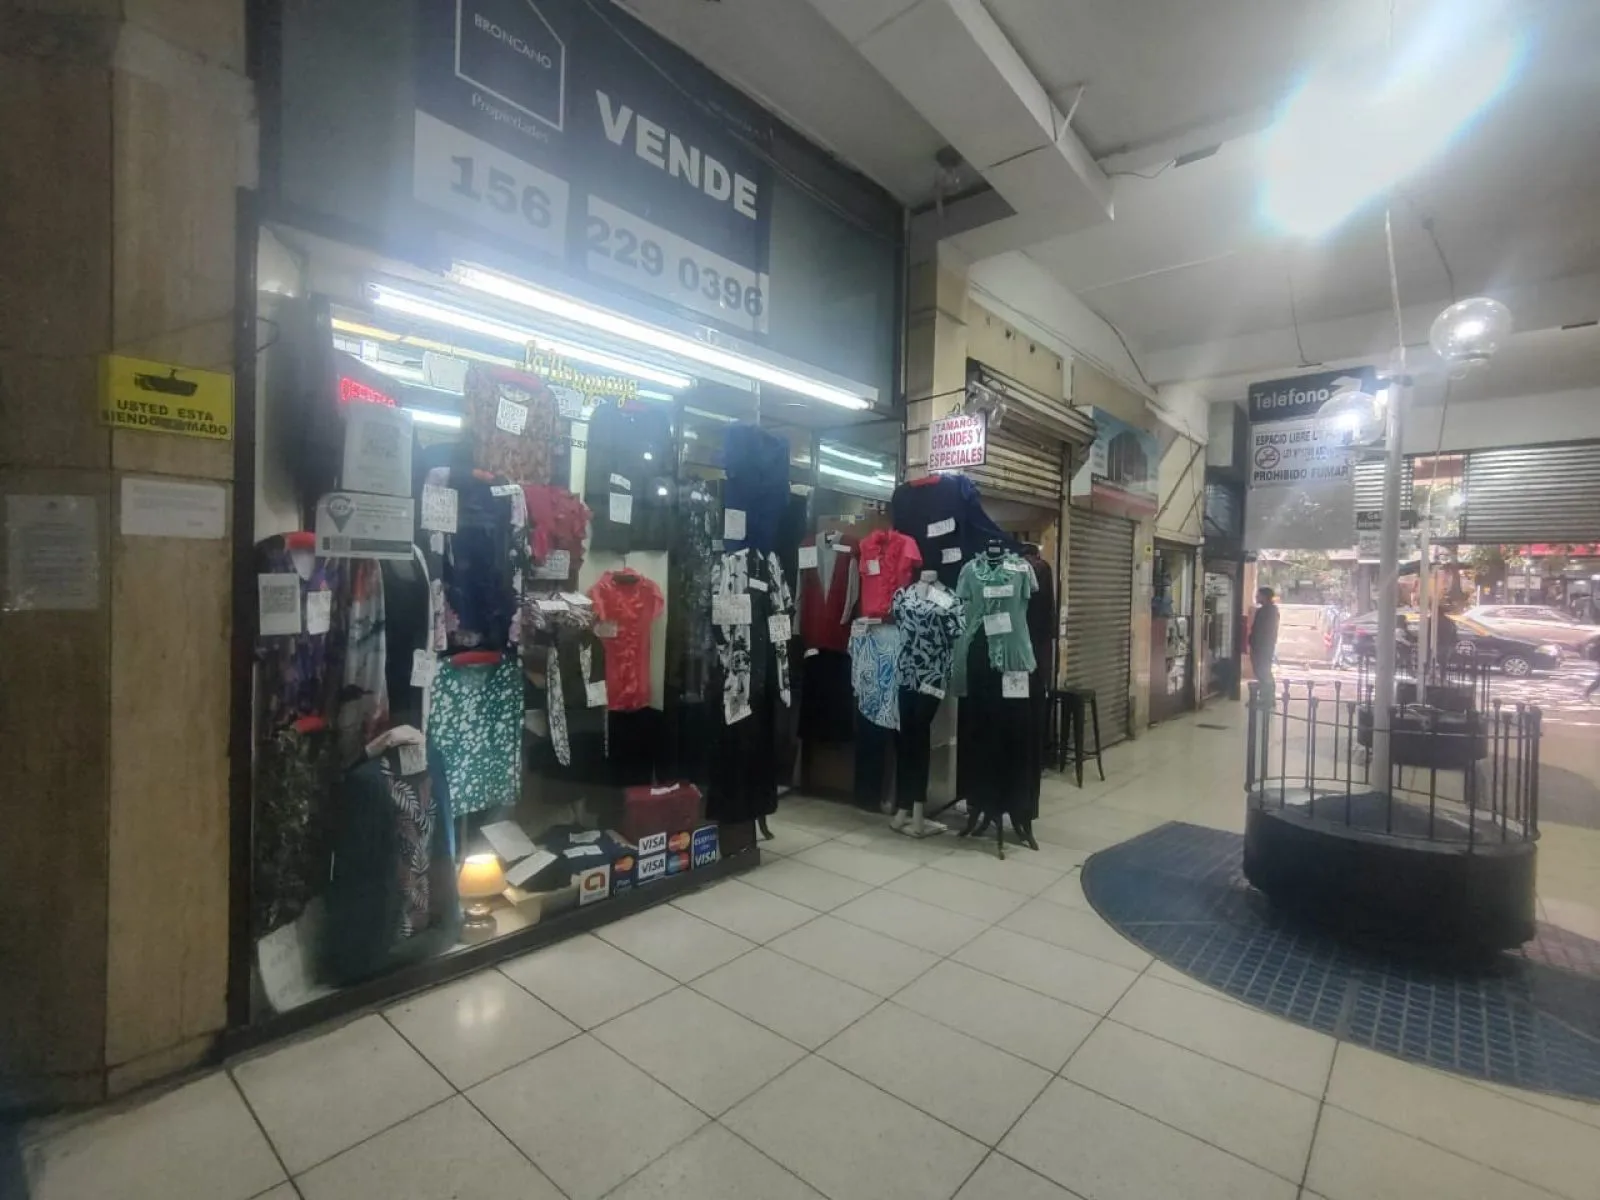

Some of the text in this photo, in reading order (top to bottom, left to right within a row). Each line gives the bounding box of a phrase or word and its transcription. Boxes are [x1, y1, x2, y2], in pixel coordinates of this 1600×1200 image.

[475, 13, 553, 69] BRONCANO
[470, 92, 549, 143] Propiedades
[595, 89, 758, 221] VENDE
[449, 154, 553, 230] 156
[586, 214, 763, 317] 229 0396
[117, 399, 214, 422] USTED ESTA
[1253, 388, 1330, 411] Teléfono
[931, 427, 983, 450] GRANDES Y
[1255, 432, 1287, 447] ESPACIO
[1289, 430, 1312, 444] LIBRE
[929, 446, 983, 468] ESPECIALES
[1254, 465, 1349, 482] PROHIBIDO FUMAR
[642, 835, 666, 851] VISA
[641, 858, 665, 874] VISA
[695, 849, 717, 868] VISA
